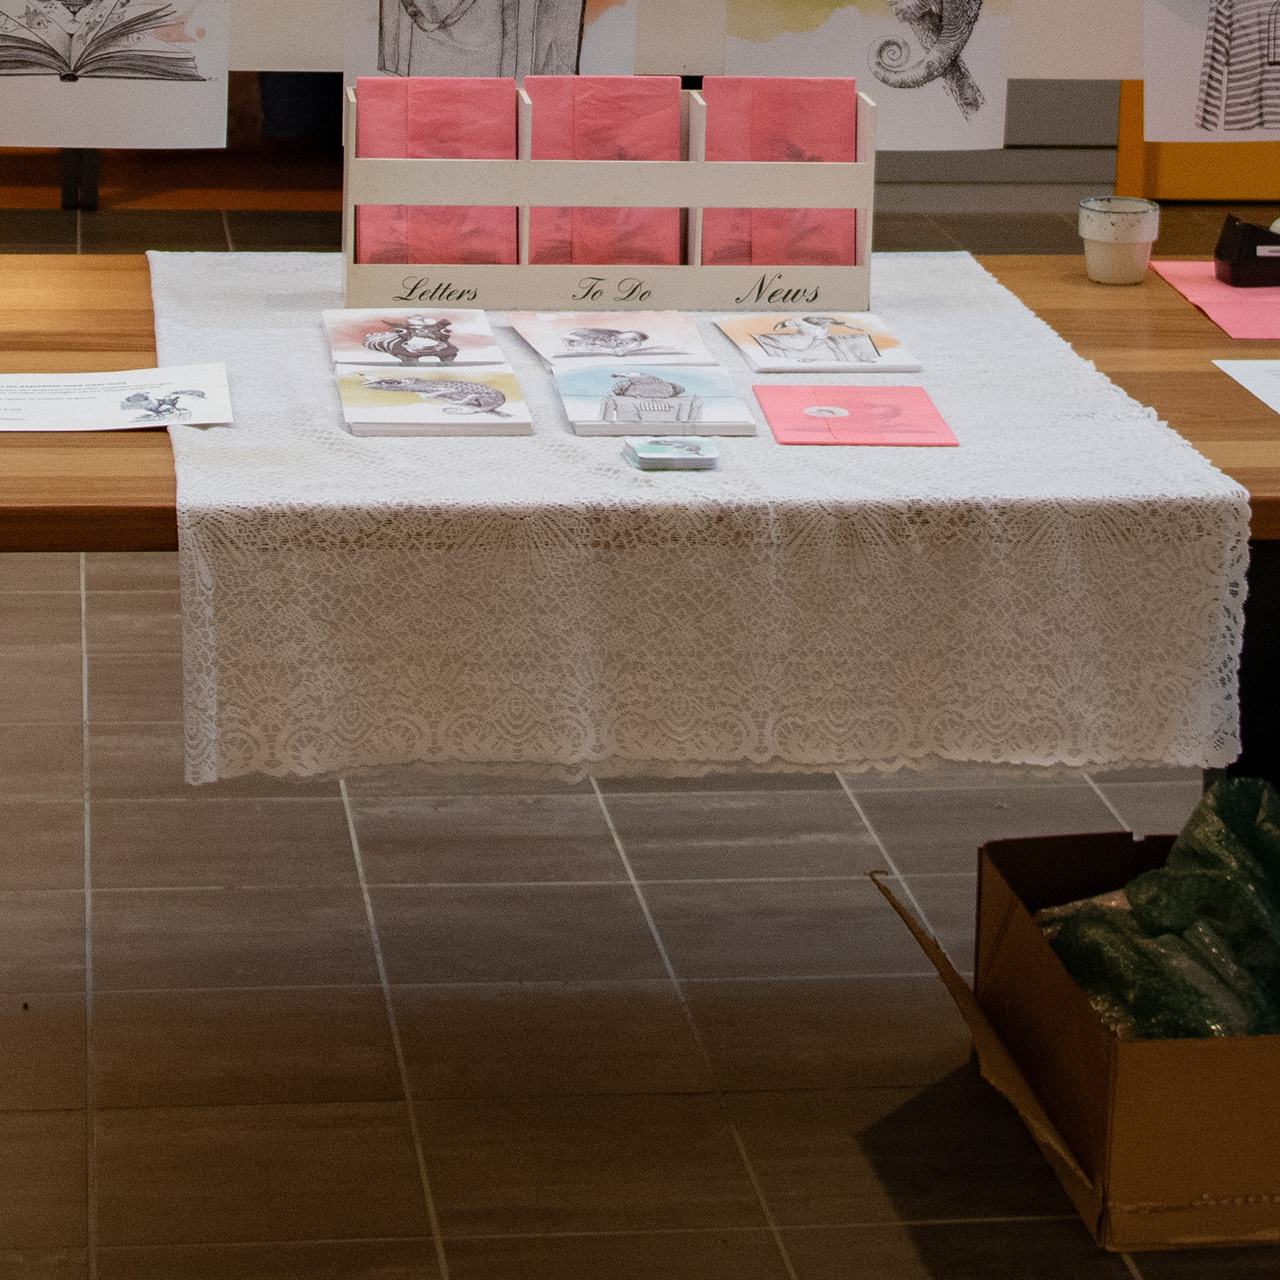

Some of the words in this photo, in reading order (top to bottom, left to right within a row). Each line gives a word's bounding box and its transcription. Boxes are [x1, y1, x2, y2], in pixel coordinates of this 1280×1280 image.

[393, 276, 478, 301] Letters
[572, 277, 605, 301] To
[613, 277, 651, 301] Do
[735, 273, 819, 304] News
